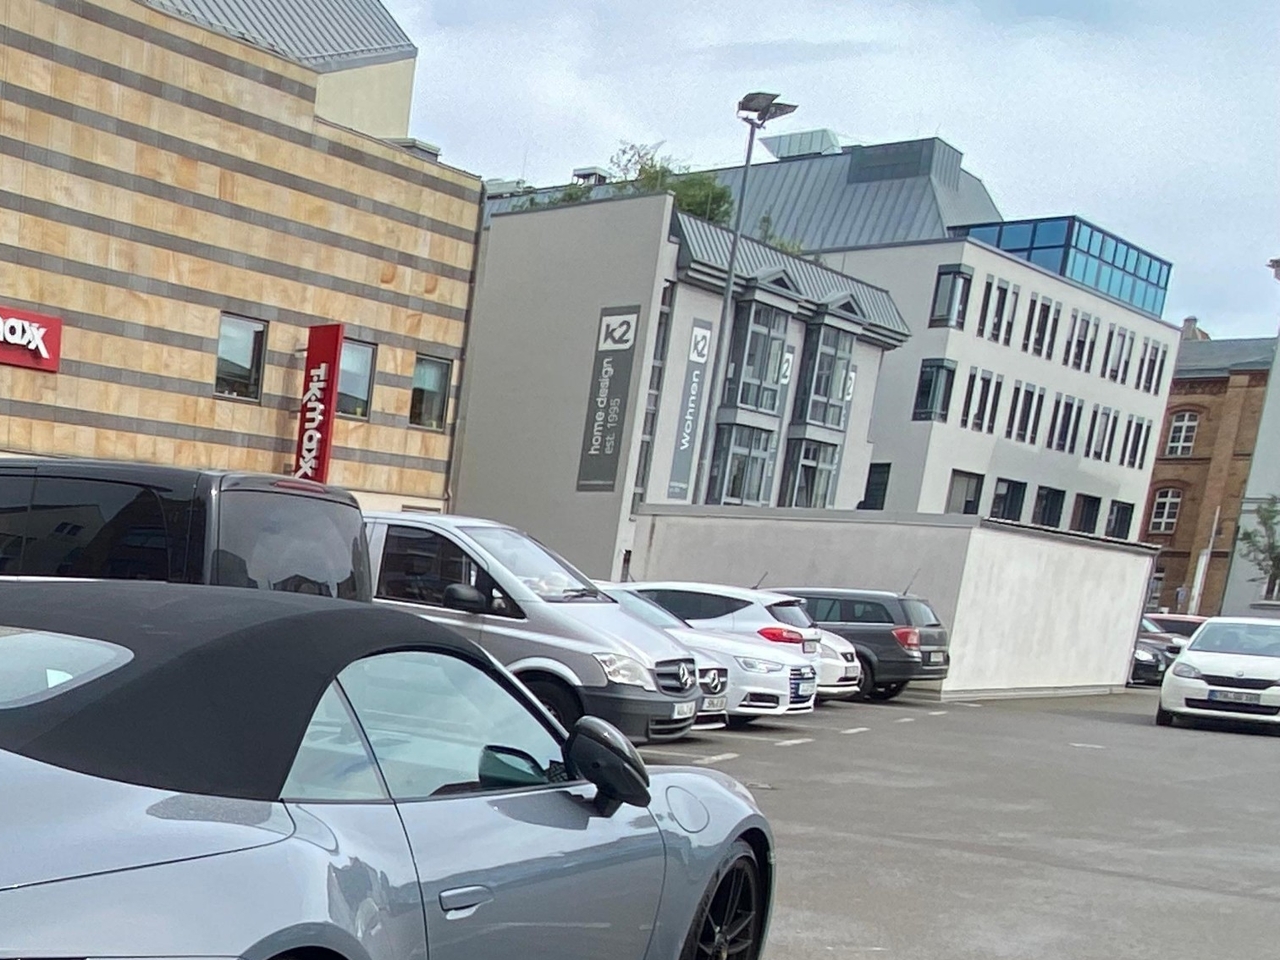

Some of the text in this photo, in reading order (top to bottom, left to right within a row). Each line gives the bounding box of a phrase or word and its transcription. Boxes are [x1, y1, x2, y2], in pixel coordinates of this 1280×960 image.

[588, 357, 614, 455] home design
[606, 398, 620, 429] 1995
[680, 370, 701, 450] wohnen
